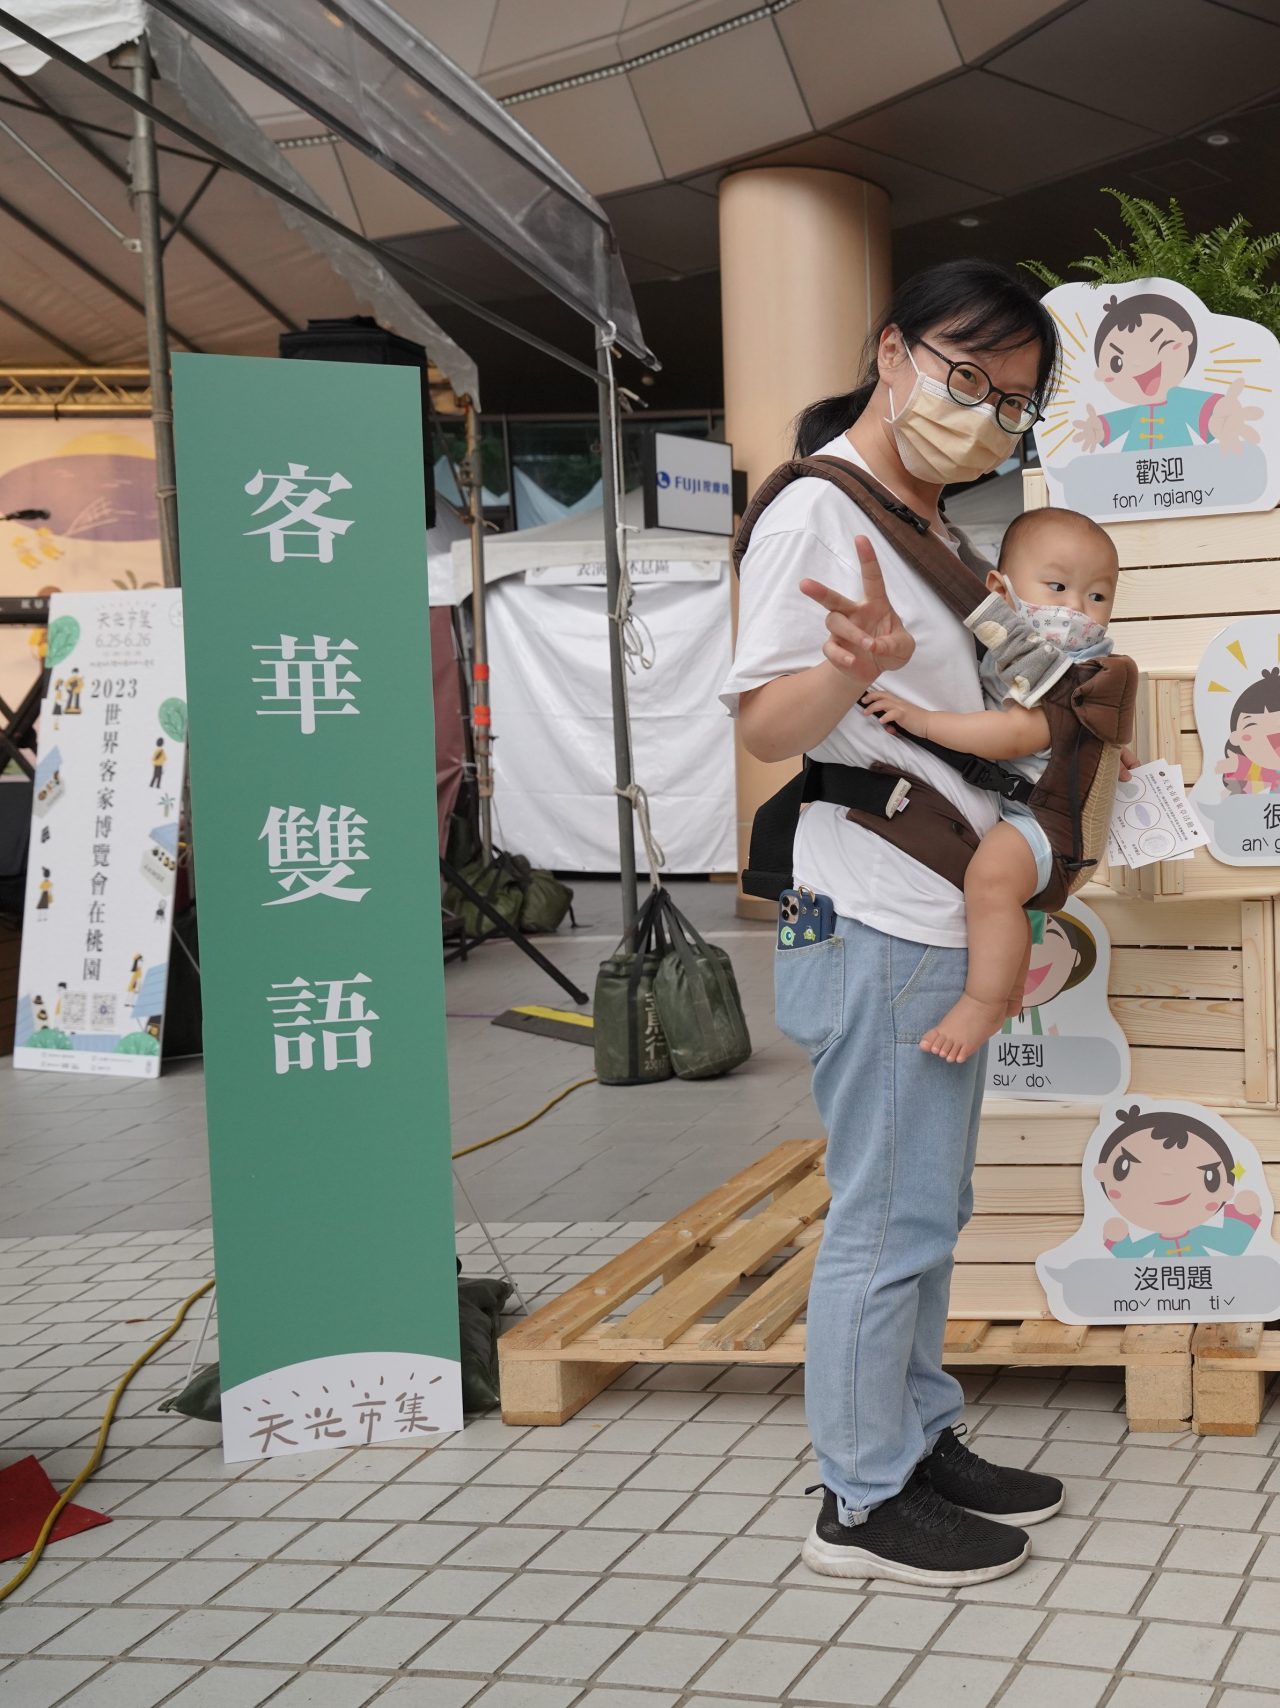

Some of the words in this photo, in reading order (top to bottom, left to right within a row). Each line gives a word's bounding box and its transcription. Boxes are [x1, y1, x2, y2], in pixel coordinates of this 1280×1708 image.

[1136, 457, 1185, 486] 歡迎
[90, 678, 138, 698] 2023
[242, 462, 381, 1075] 客華雙語
[997, 1042, 1044, 1068] 收到
[1133, 1265, 1213, 1291] 沒問題
[1157, 1297, 1191, 1311] mun
[249, 1392, 440, 1453] 天光市集
